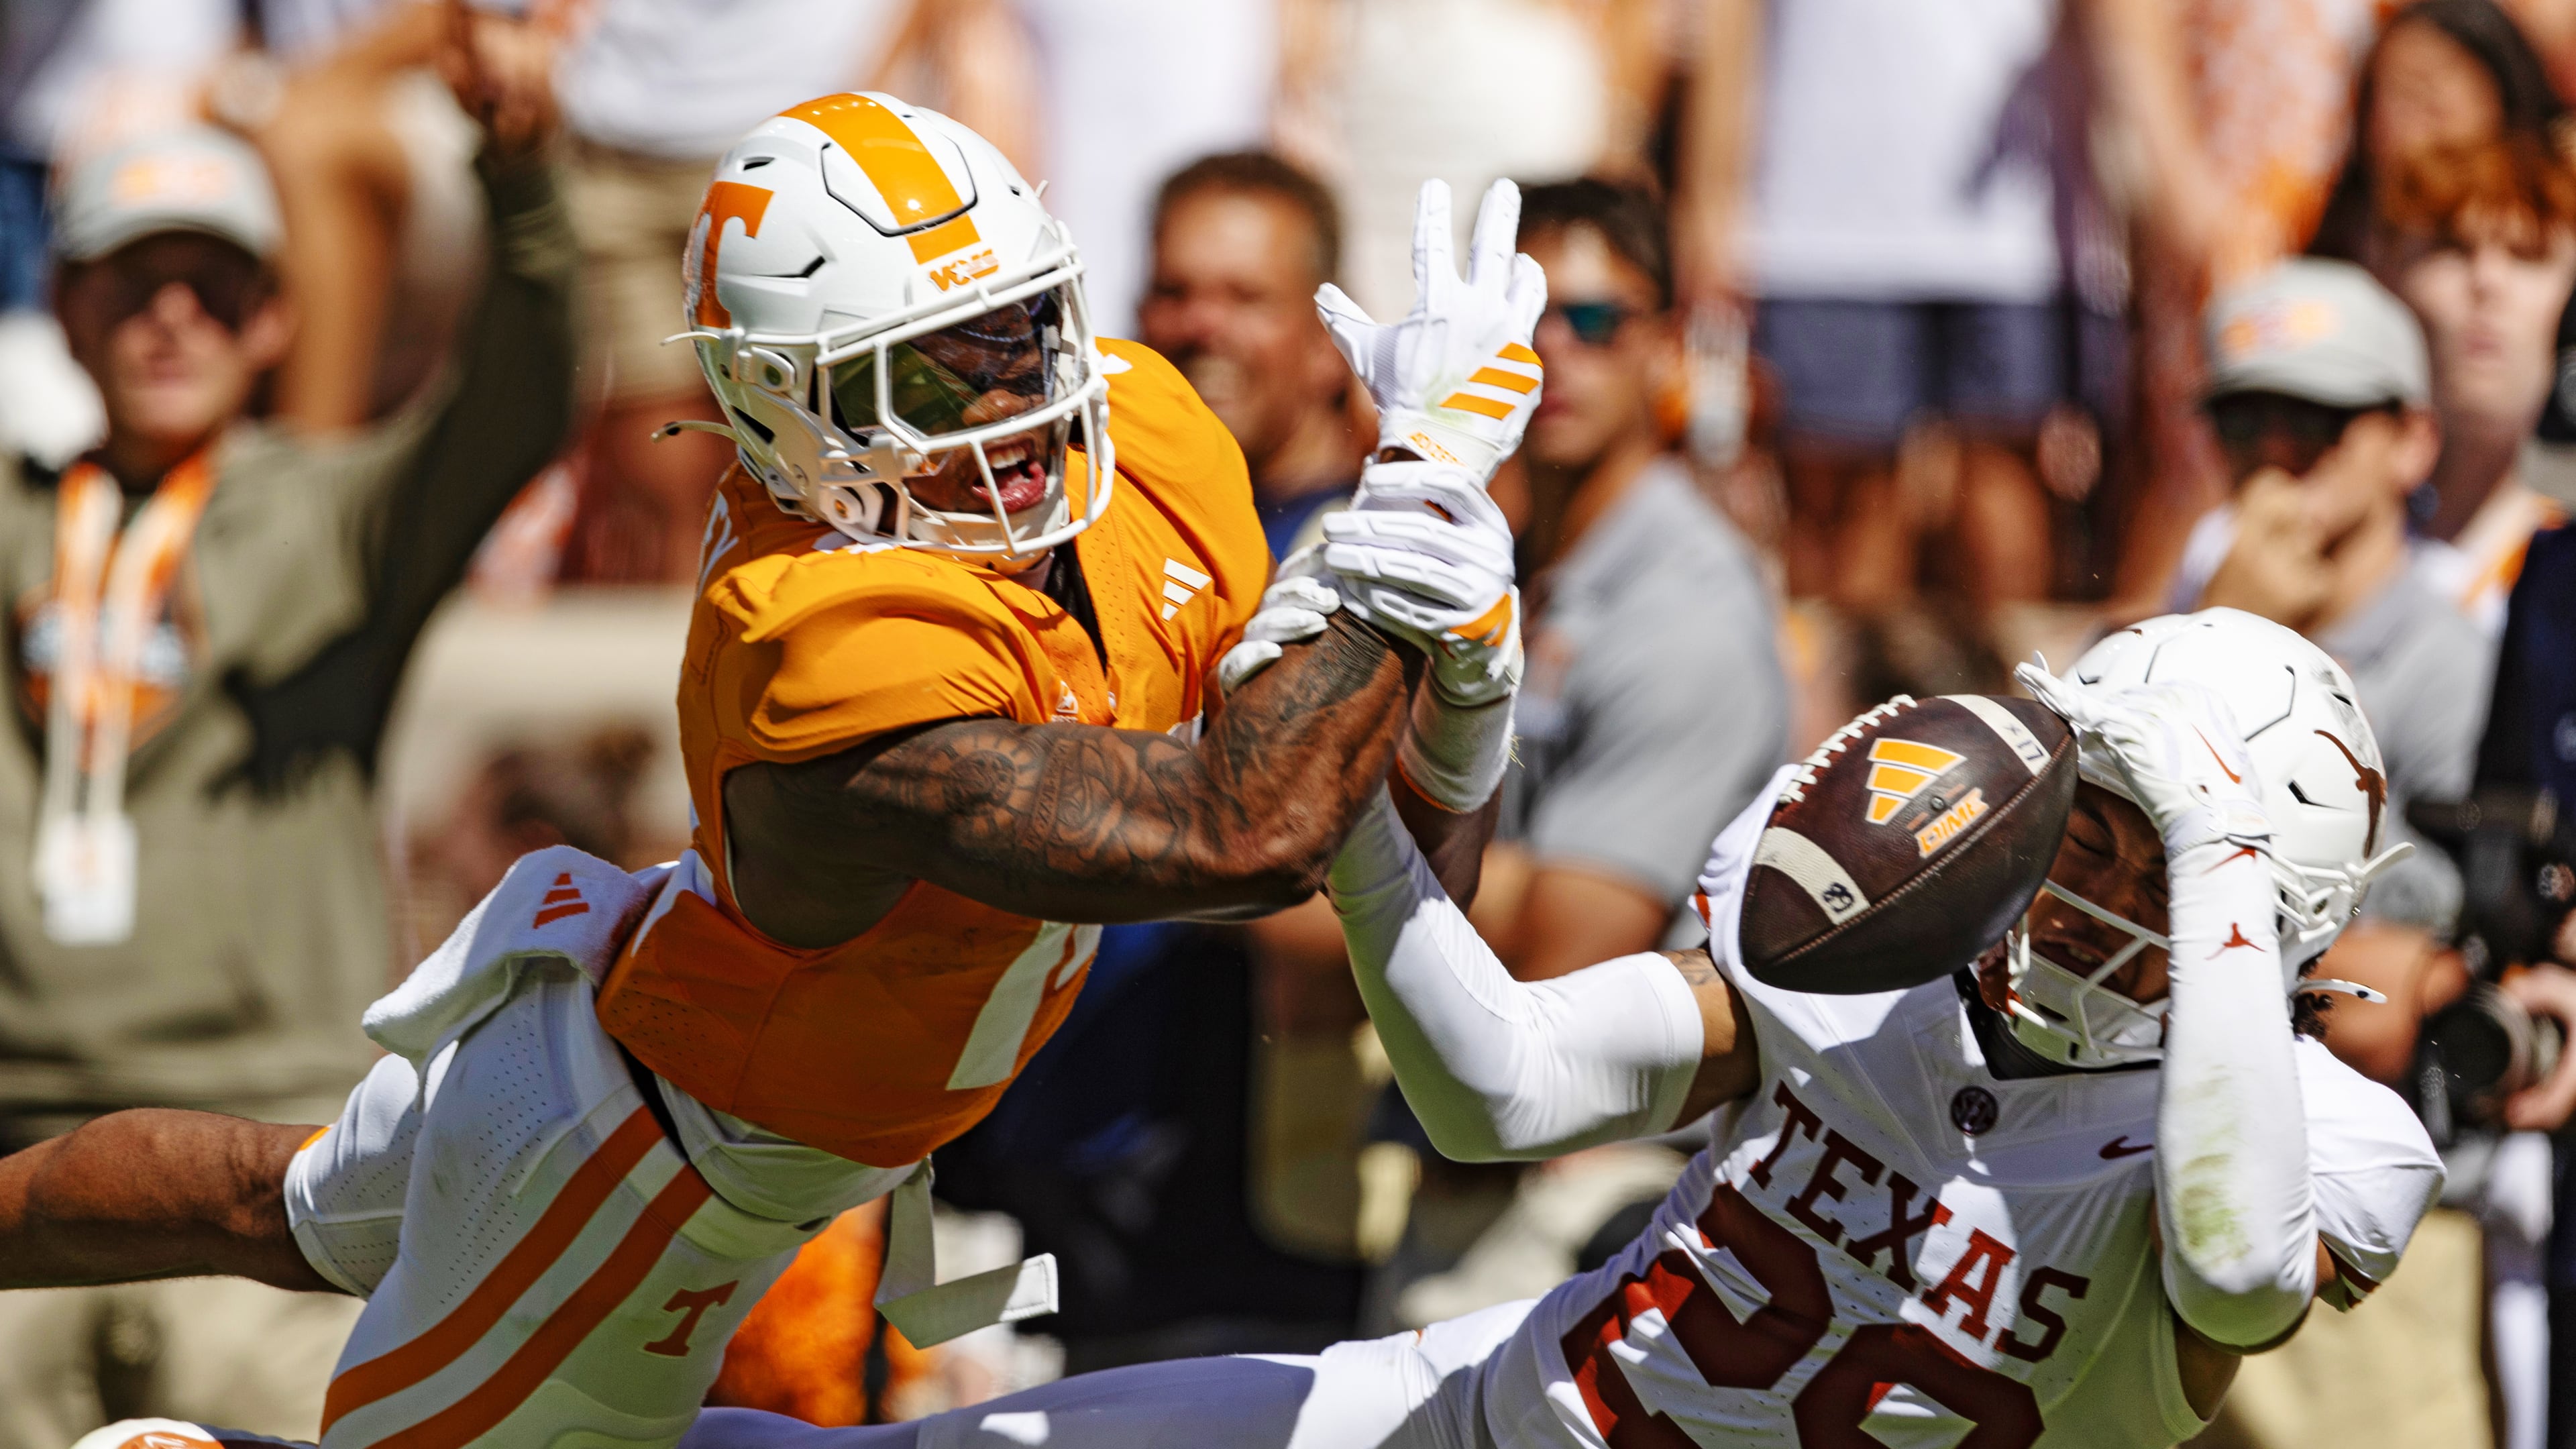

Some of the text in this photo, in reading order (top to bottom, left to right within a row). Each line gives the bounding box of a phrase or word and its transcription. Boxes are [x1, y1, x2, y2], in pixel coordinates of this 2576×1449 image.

[695, 180, 775, 329] T
[1749, 1079, 2091, 1363] TEXAS
[643, 1279, 739, 1357] T
